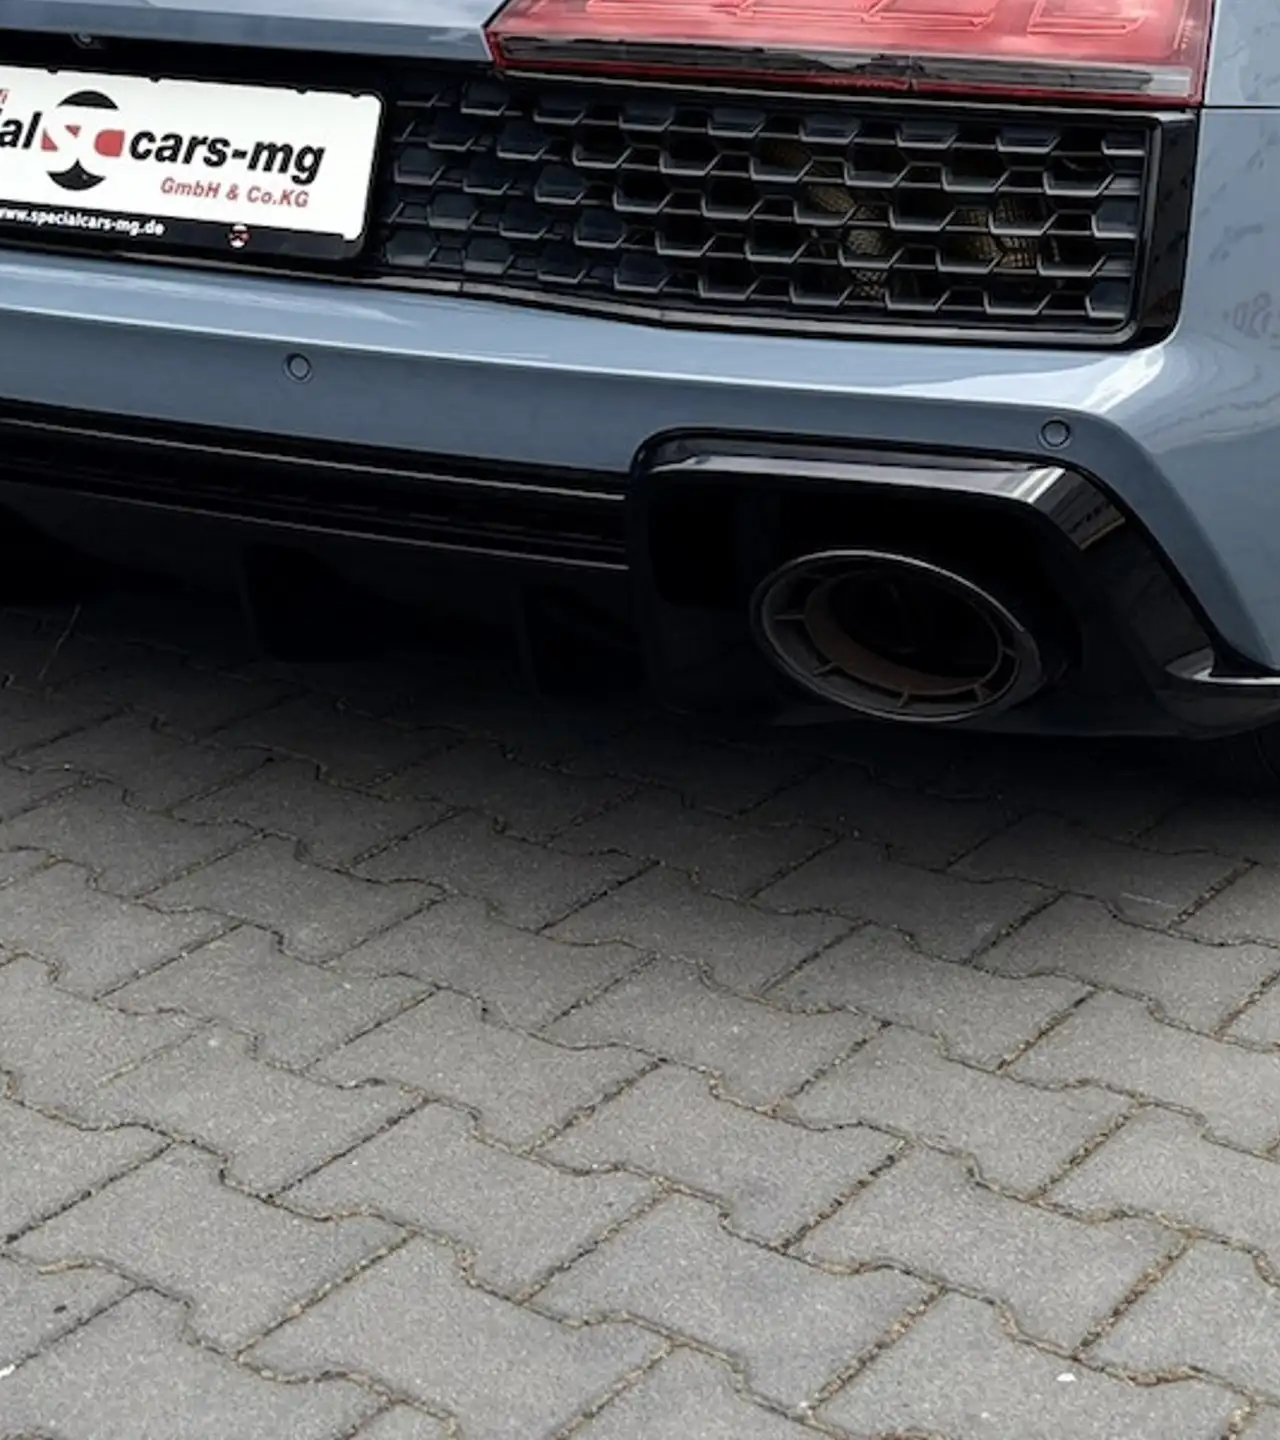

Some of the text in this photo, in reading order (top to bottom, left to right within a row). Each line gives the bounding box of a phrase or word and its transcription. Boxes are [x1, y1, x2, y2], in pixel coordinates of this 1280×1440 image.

[128, 129, 327, 187] cars-mg
[160, 176, 311, 209] GmbH & Co.KG
